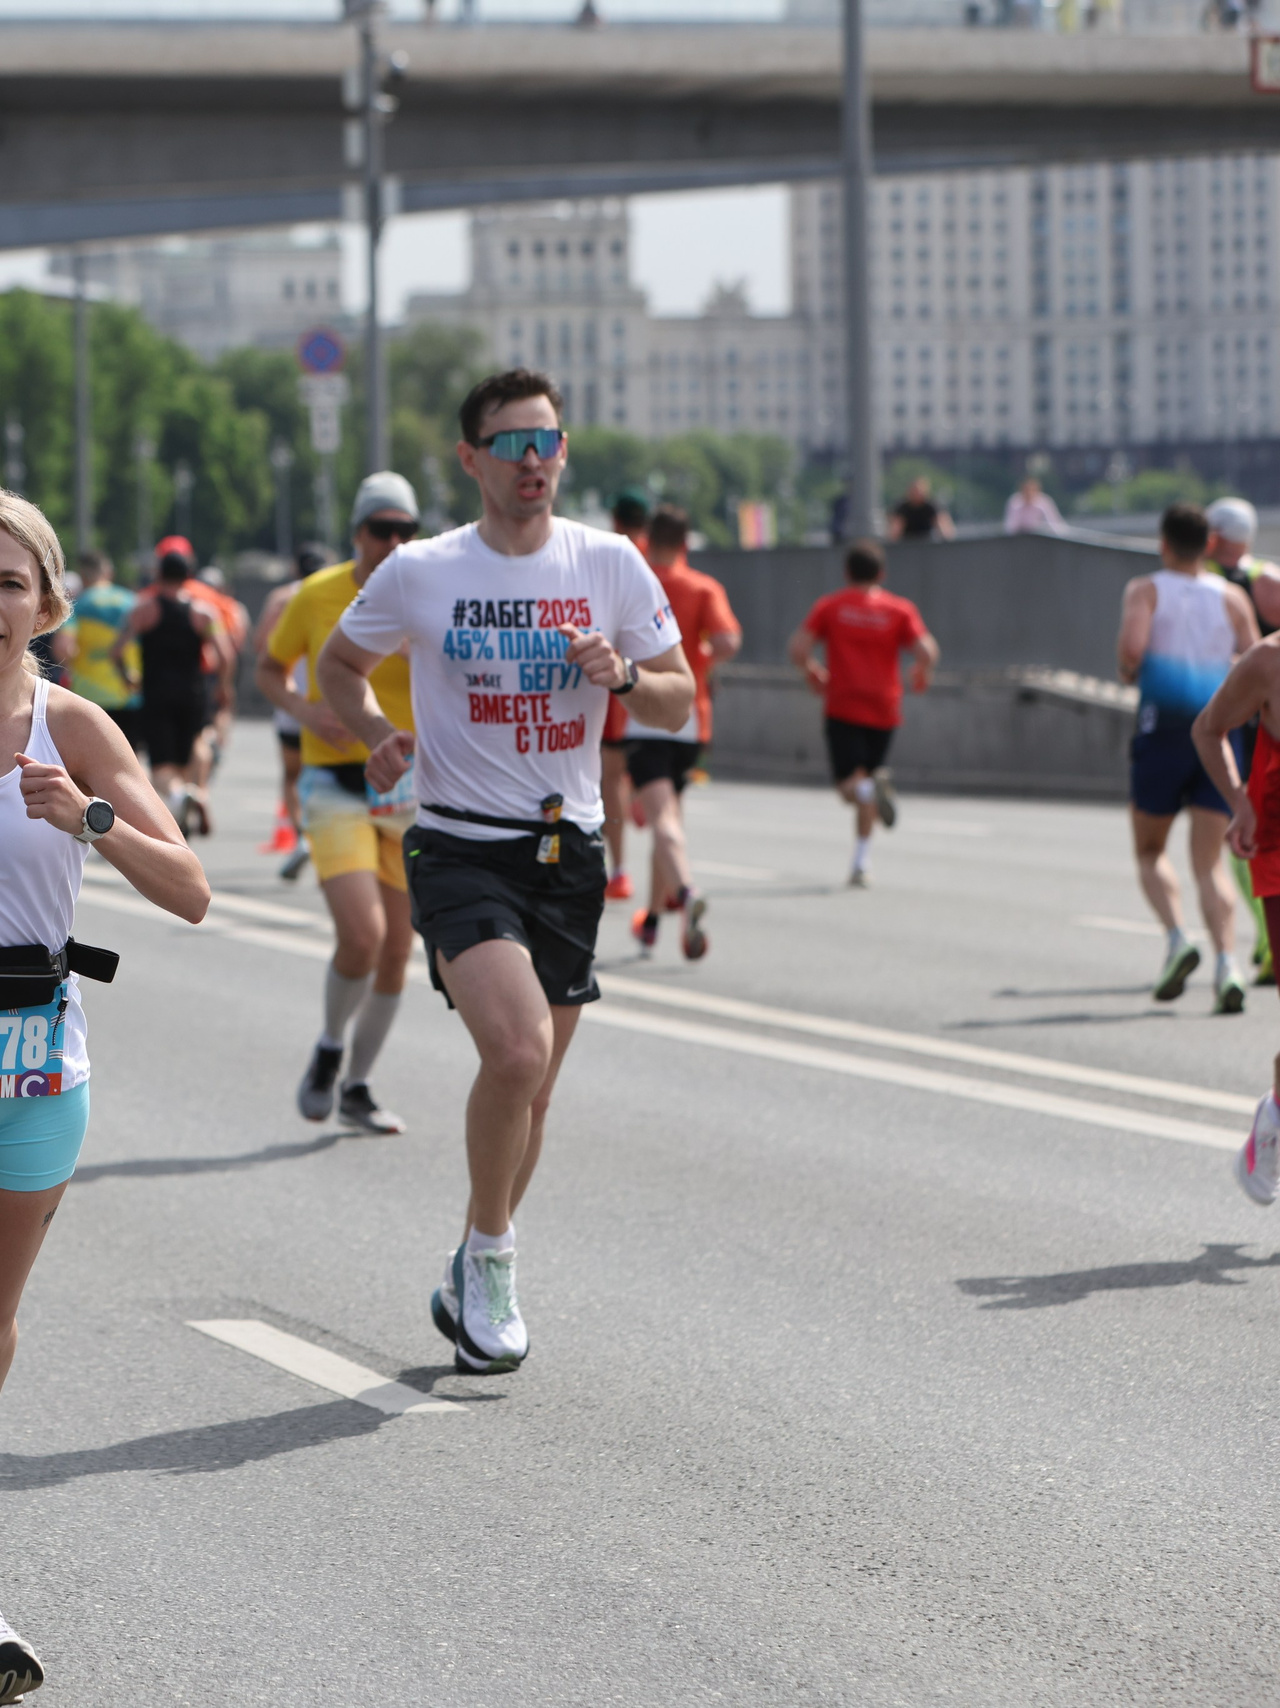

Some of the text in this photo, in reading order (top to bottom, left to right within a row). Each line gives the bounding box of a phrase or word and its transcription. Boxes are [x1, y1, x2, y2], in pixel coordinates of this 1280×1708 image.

[443, 630, 494, 661] 45%
[468, 693, 553, 725] ВМЕСТЕ
[516, 713, 586, 754] С ТОБОЙ
